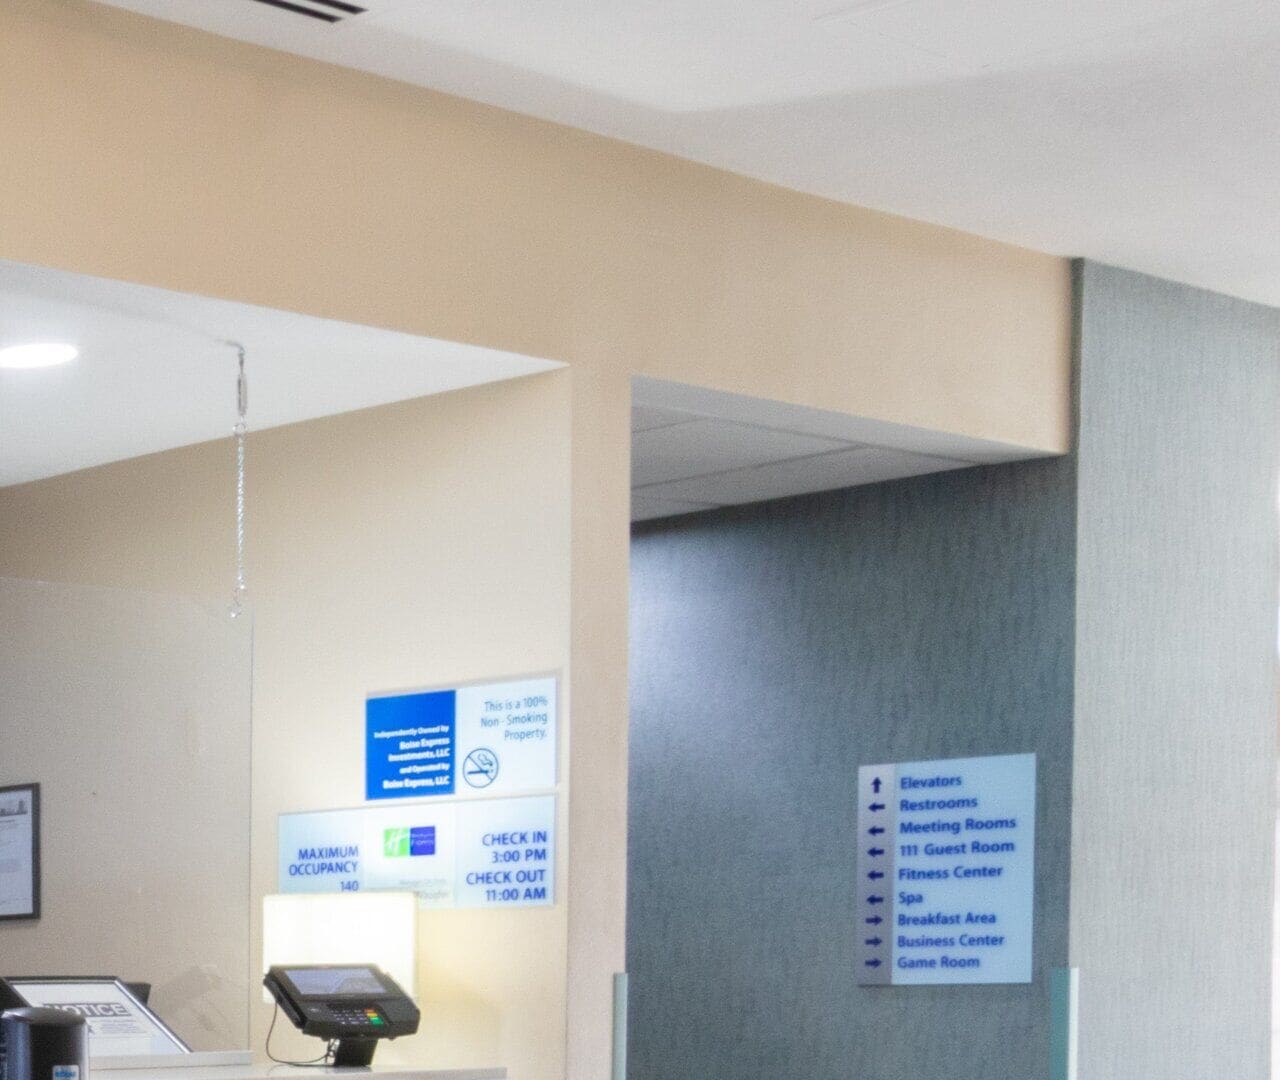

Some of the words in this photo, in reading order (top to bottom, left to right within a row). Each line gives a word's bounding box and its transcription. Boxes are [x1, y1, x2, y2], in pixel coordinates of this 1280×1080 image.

[484, 701, 502, 712] This
[505, 700, 513, 711] is
[515, 702, 521, 710] a
[524, 696, 548, 708] 100%
[481, 717, 500, 728] Non
[507, 711, 548, 725] Smoking
[436, 748, 450, 757] LLC
[900, 776, 962, 790] Elevators
[900, 797, 978, 811] Restrooms
[899, 820, 961, 835] Meeting
[965, 818, 1016, 830] Rooms
[482, 831, 529, 847] CHECK
[532, 830, 547, 843] IN
[298, 845, 359, 860] MAXIMUM
[900, 845, 918, 856] 111
[924, 843, 966, 856] Guest
[971, 841, 1015, 853] Room
[491, 850, 520, 863] 3:00
[525, 849, 546, 861] PM
[289, 861, 358, 876] OCCUPANCY
[898, 868, 949, 880] Fitness
[953, 865, 1003, 878] Center
[466, 871, 513, 885] CHECK
[516, 869, 546, 883] OUT
[340, 881, 359, 892] 140
[486, 889, 518, 902] 11:00
[523, 887, 546, 900] AM
[898, 892, 924, 906] Spa
[897, 913, 960, 926] Breakfast
[964, 912, 996, 924] Area
[897, 935, 955, 947] Business
[958, 934, 1005, 946] Center
[897, 956, 937, 969] Game
[940, 955, 980, 968] Room
[46, 1003, 129, 1015] OTICE
